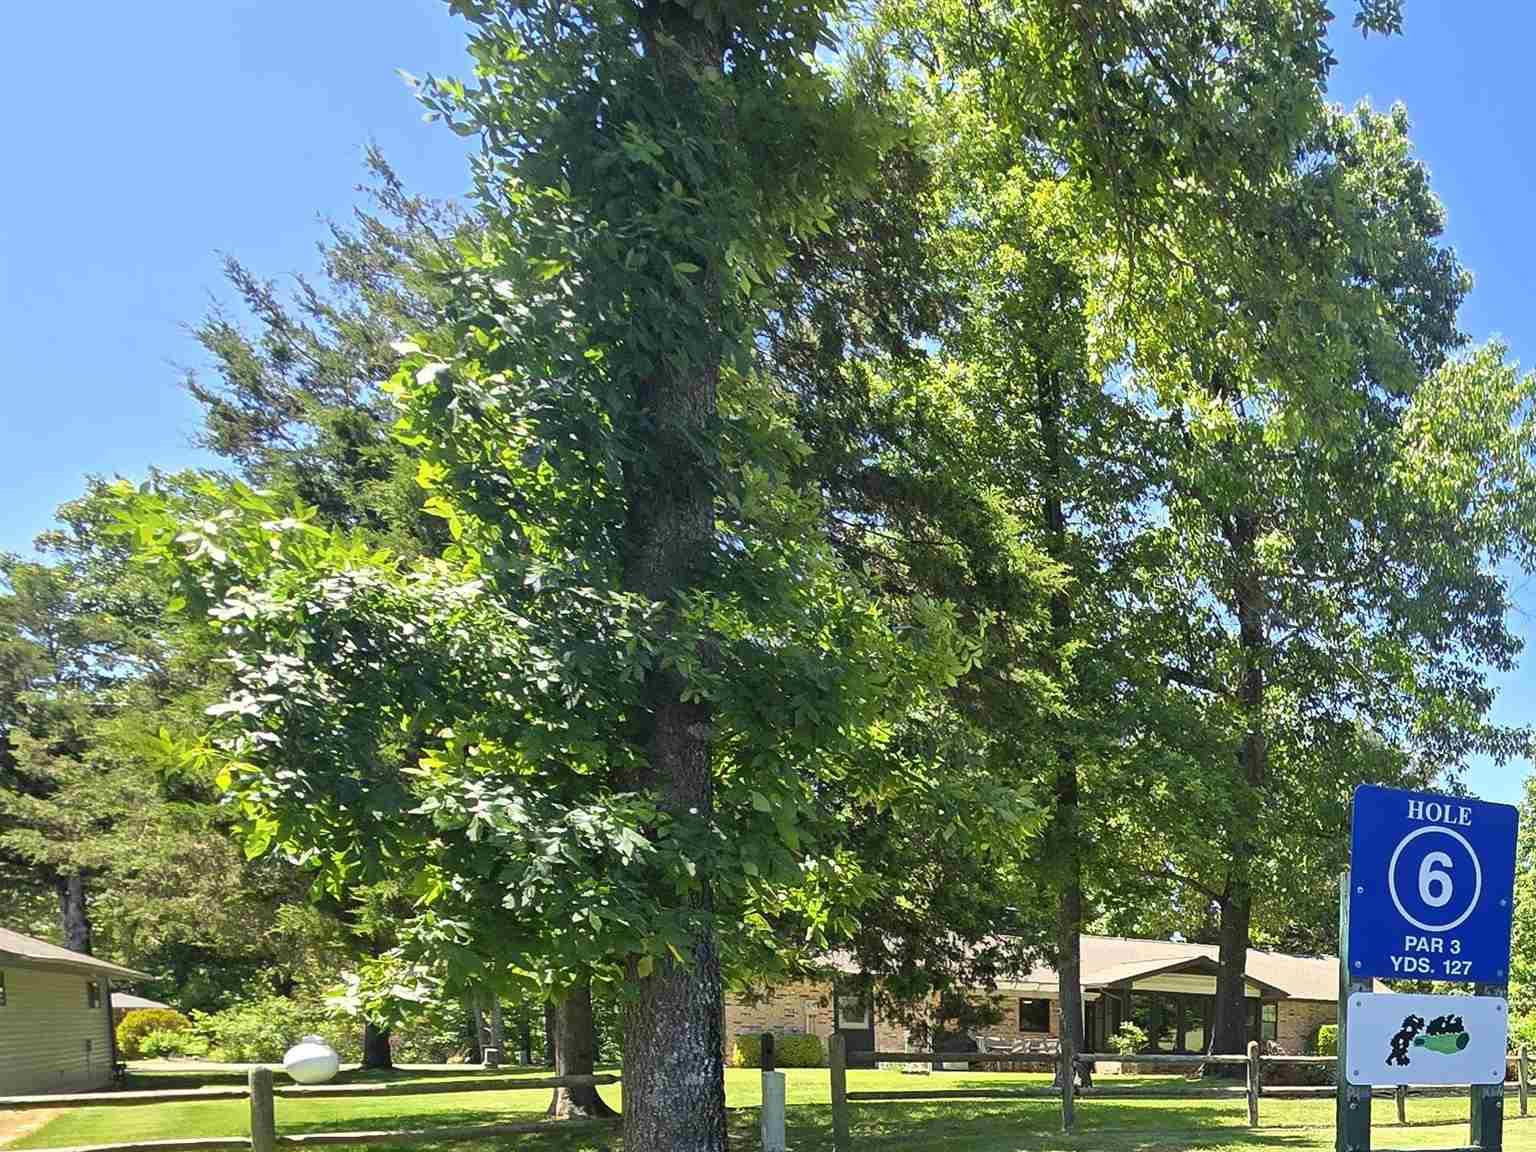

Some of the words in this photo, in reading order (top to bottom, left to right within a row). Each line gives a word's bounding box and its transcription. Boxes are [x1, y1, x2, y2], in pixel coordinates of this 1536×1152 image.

[1407, 799, 1472, 826] HOLE
[1418, 851, 1453, 907] 6
[1405, 935, 1444, 953] PAR
[1450, 939, 1461, 955] 3
[1390, 955, 1435, 974] YDS.
[1443, 960, 1473, 976] 127
